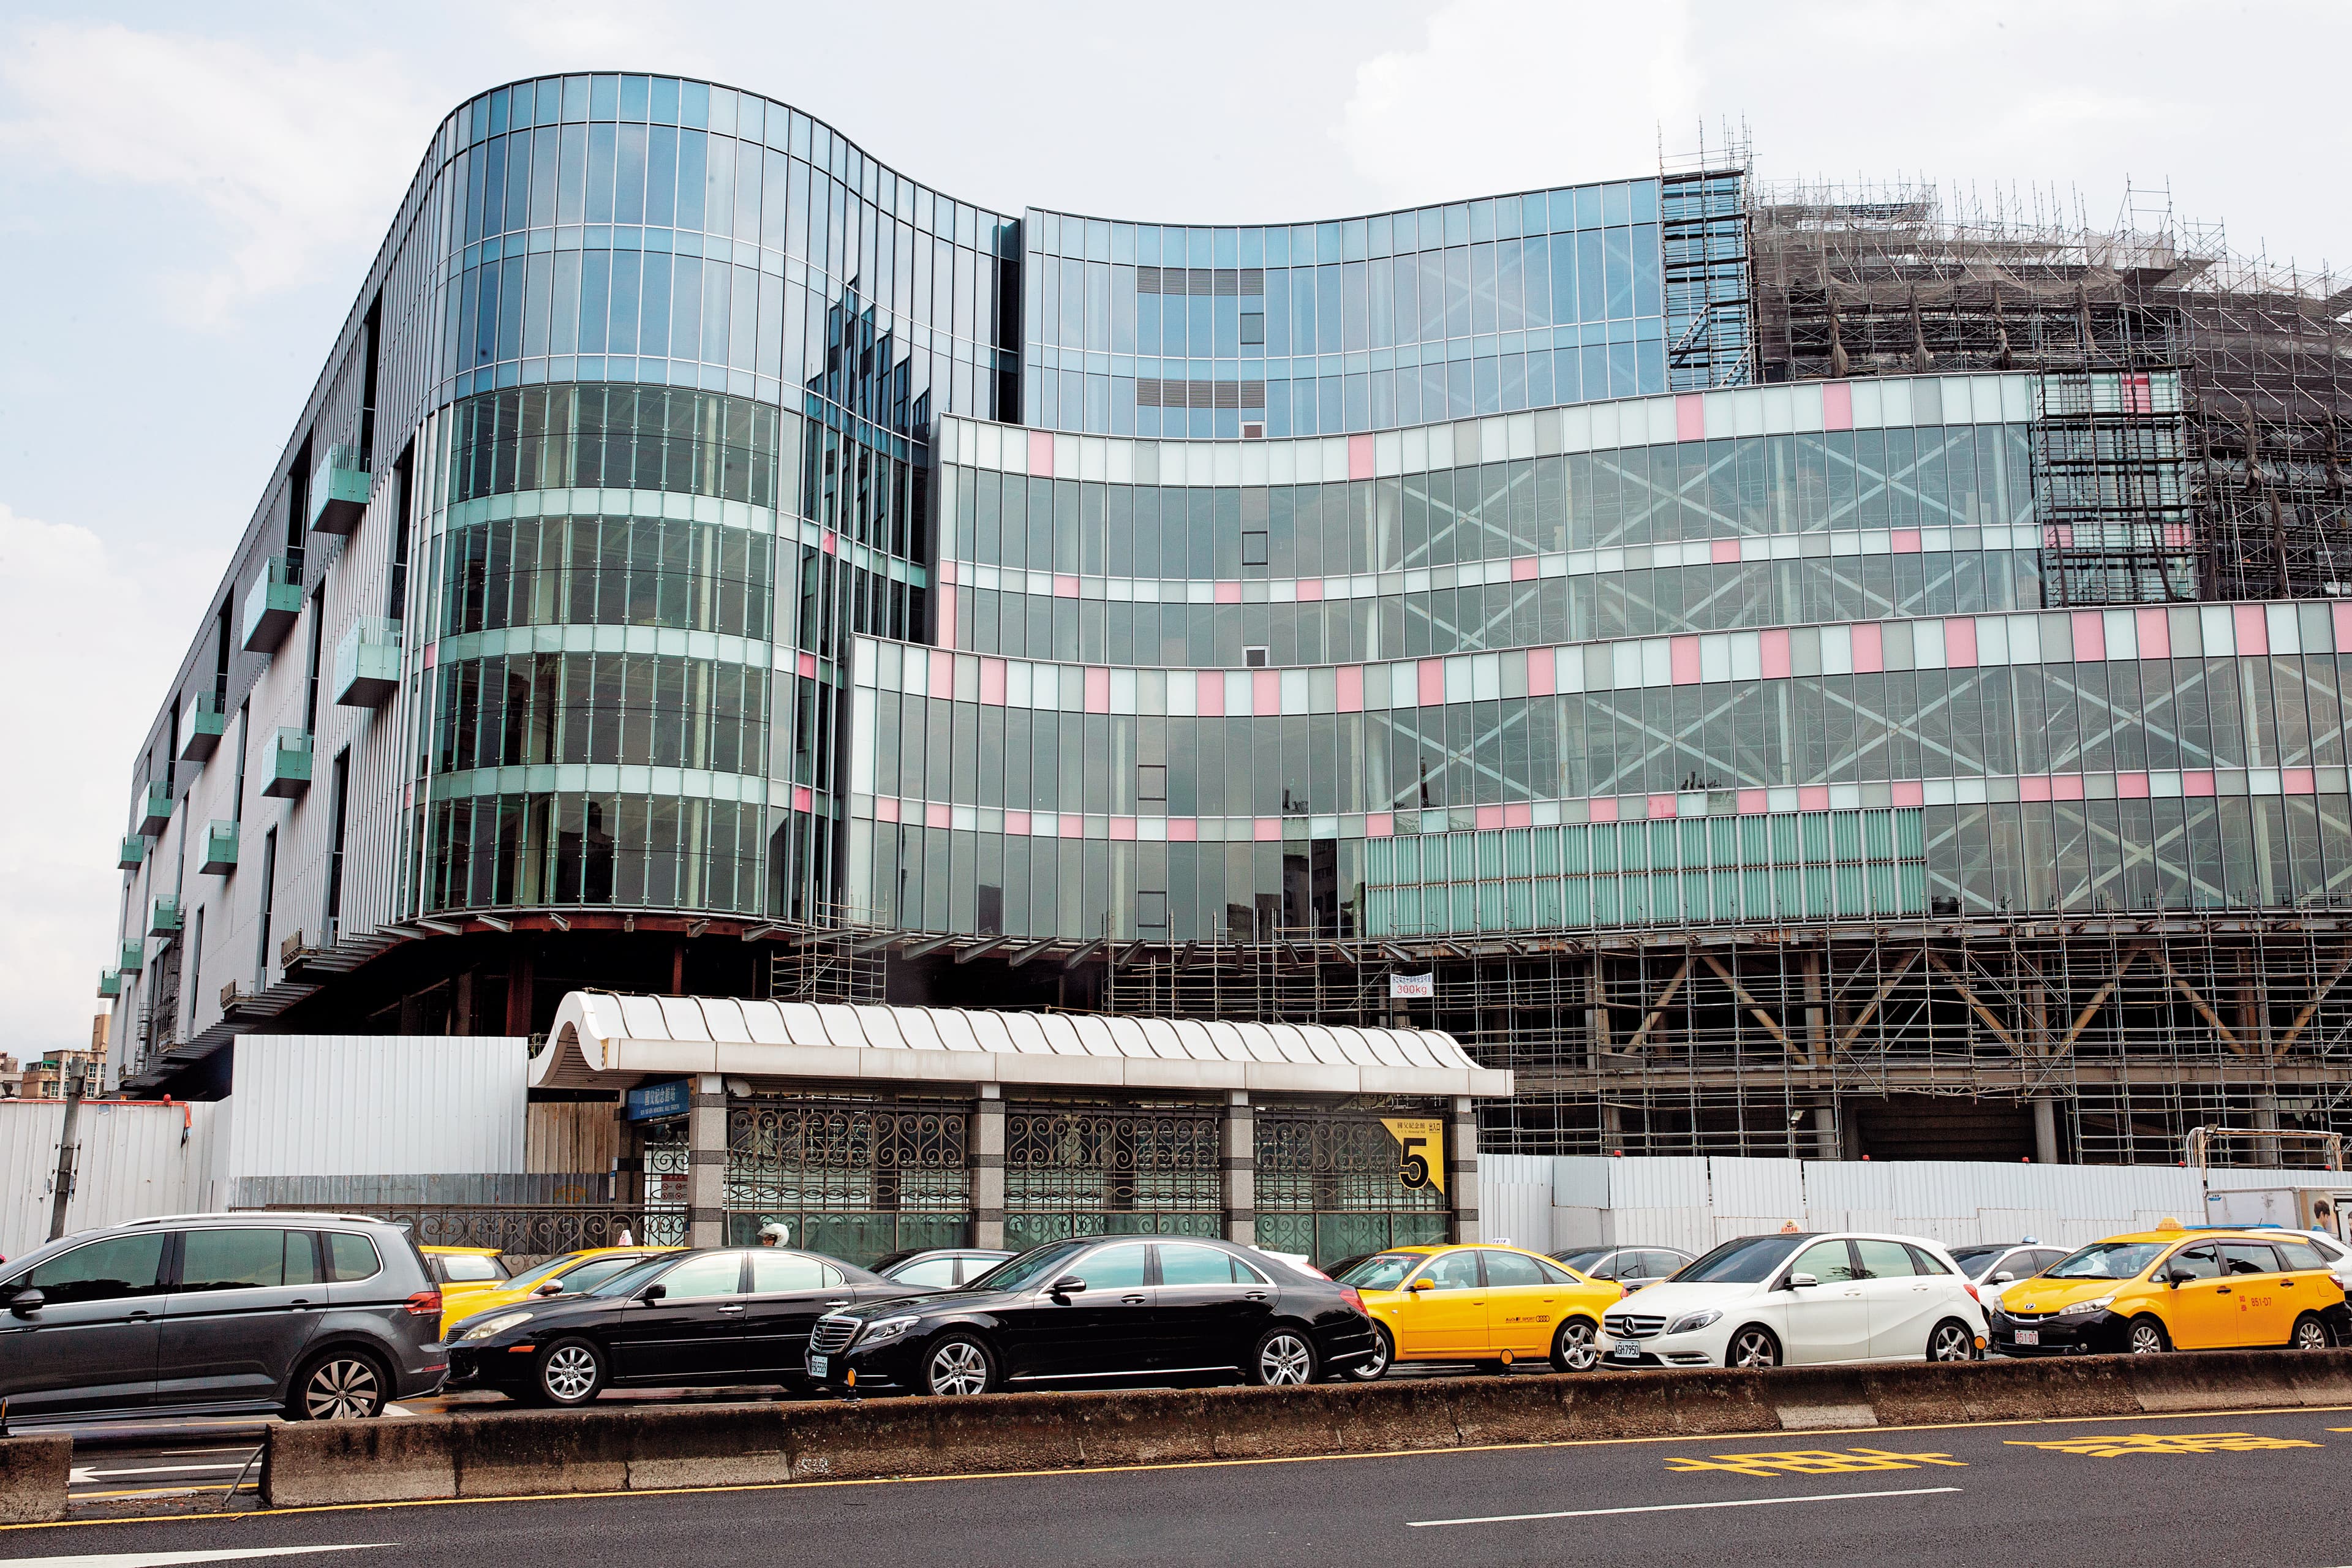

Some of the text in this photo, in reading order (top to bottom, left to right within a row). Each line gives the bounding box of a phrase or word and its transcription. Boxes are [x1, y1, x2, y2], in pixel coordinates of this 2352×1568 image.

[1397, 985, 1427, 995] 300kg
[644, 1085, 676, 1106] 國父紀念館站
[1428, 1122, 1441, 1131] 出入口
[1400, 1137, 1429, 1189] 5
[2251, 1297, 2272, 1306] 851-D7
[2016, 1333, 2037, 1343] 851-D7
[1615, 1344, 1639, 1355] AGH-7950
